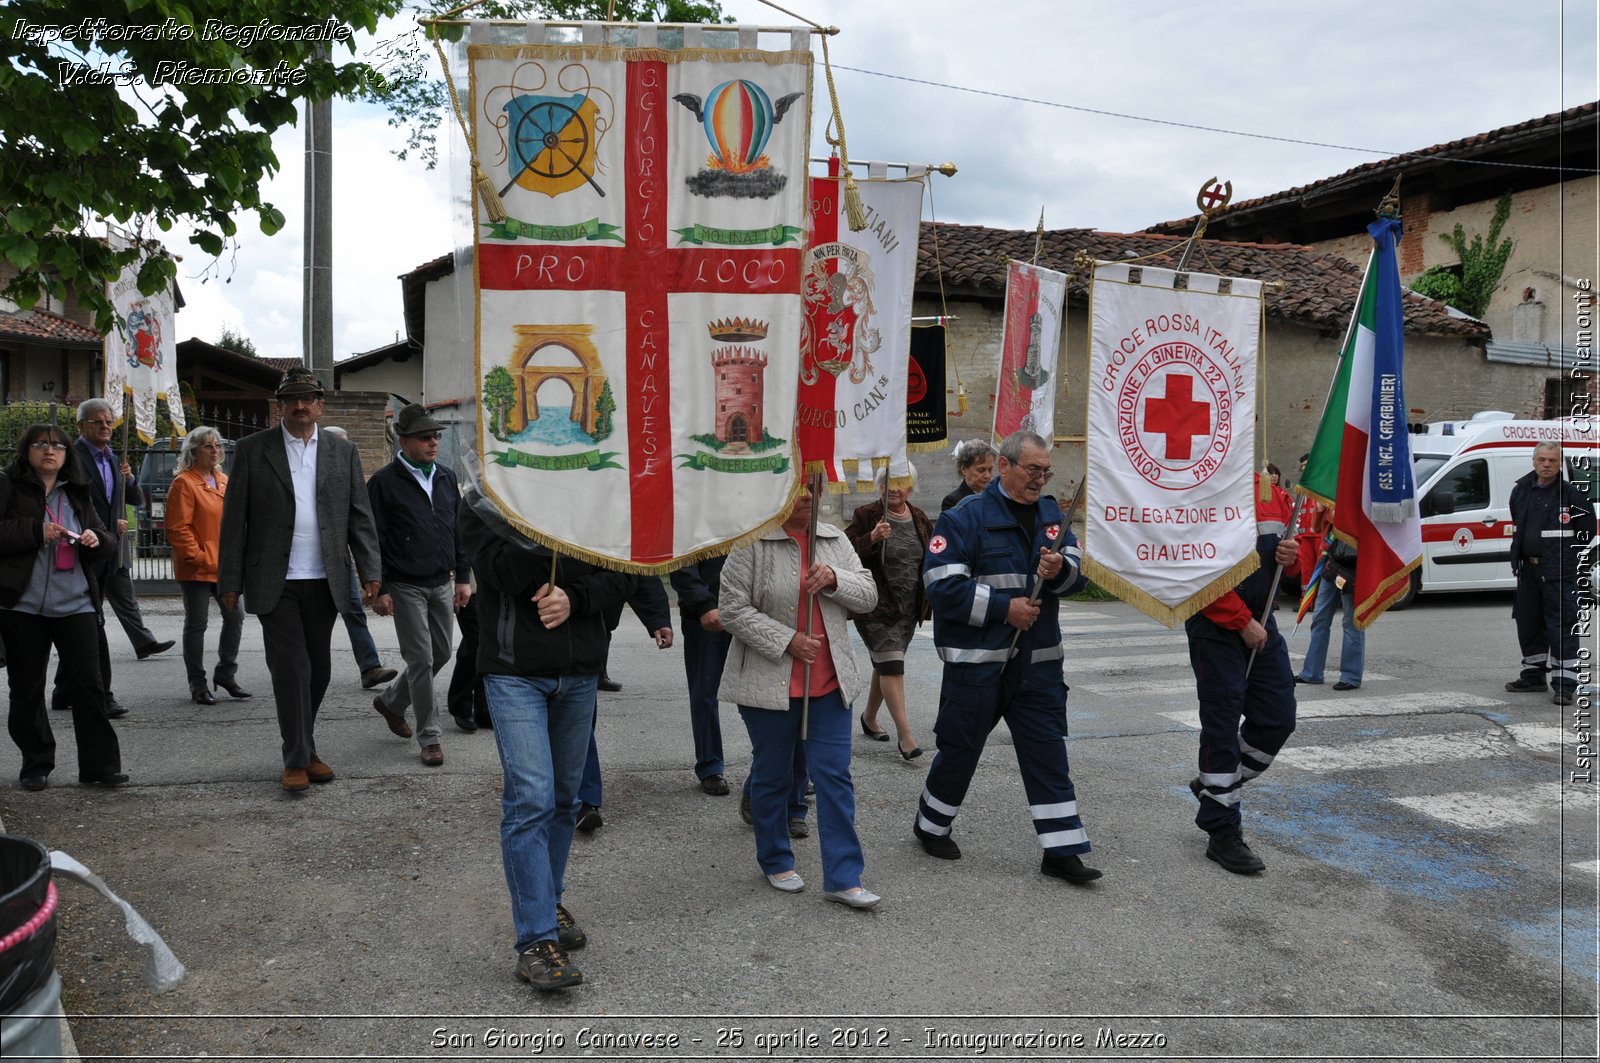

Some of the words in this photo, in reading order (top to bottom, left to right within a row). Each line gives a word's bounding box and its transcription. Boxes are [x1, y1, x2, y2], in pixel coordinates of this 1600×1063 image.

[519, 224, 589, 241] RITANIA
[701, 228, 779, 245] MOLINATTO
[813, 247, 826, 261] NON
[826, 244, 841, 258] PER
[512, 253, 585, 283] PRO
[695, 258, 785, 284] LOCO
[1102, 328, 1145, 392] CROCE
[1145, 313, 1200, 337] ROSSA
[1204, 326, 1246, 402] ITALIANA
[1151, 345, 1203, 368] GINEVRA
[1138, 359, 1152, 377] DI
[1204, 366, 1222, 385] 22
[637, 310, 660, 478] CANAVESE
[1379, 374, 1396, 440] CARABINIERI
[1120, 376, 1161, 481] CONVENZIONE
[1214, 390, 1230, 453] AGOSTO
[1502, 426, 1537, 439] CROCE
[1538, 427, 1571, 440] ROSSA
[516, 453, 592, 469] PIATONIA
[700, 454, 778, 472] CORTEREGGIO
[1379, 443, 1394, 466] NAZ.
[1192, 455, 1218, 482] 1864
[1379, 469, 1394, 490] ASS.
[1105, 506, 1217, 524] DELEGAZIONE
[1224, 506, 1242, 522] DI
[1136, 542, 1217, 561] GIAVENO
